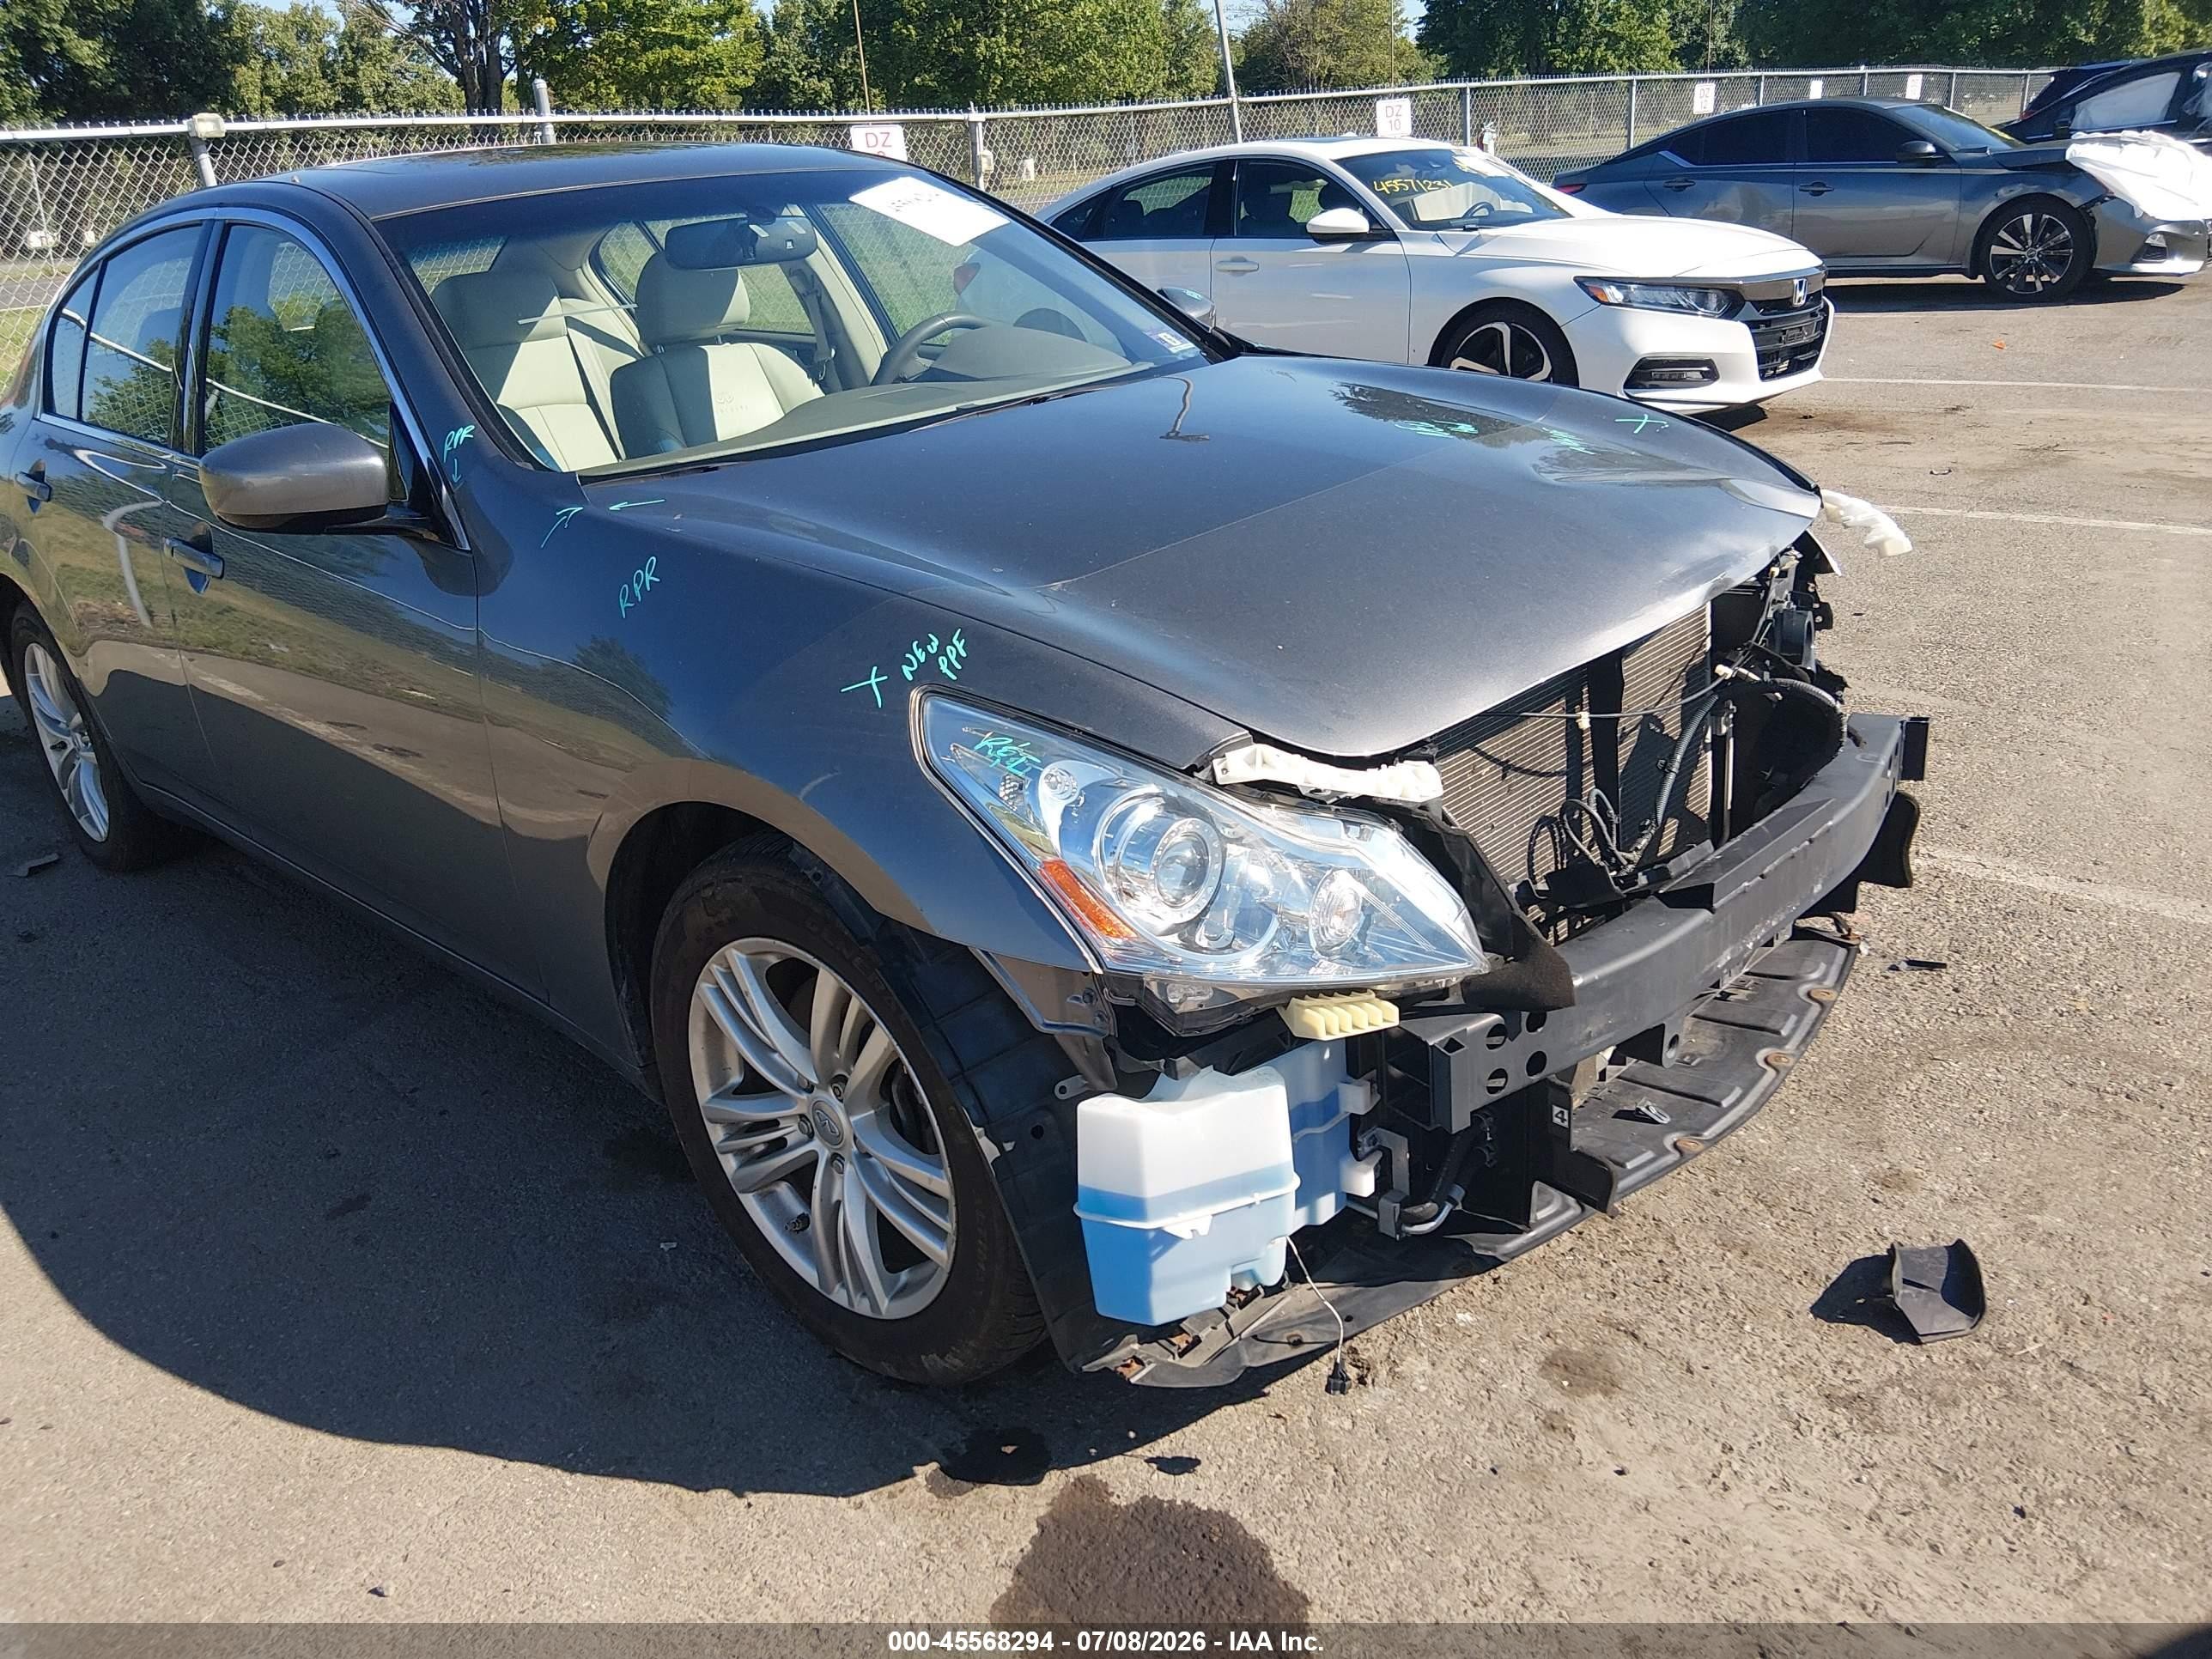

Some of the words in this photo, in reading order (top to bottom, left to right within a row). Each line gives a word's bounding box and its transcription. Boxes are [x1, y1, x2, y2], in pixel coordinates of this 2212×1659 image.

[1385, 105, 1402, 118] DZ
[1389, 119, 1401, 131] 10
[865, 131, 892, 148] DZ
[1373, 179, 1453, 194] 45571231
[618, 556, 660, 618] RPR
